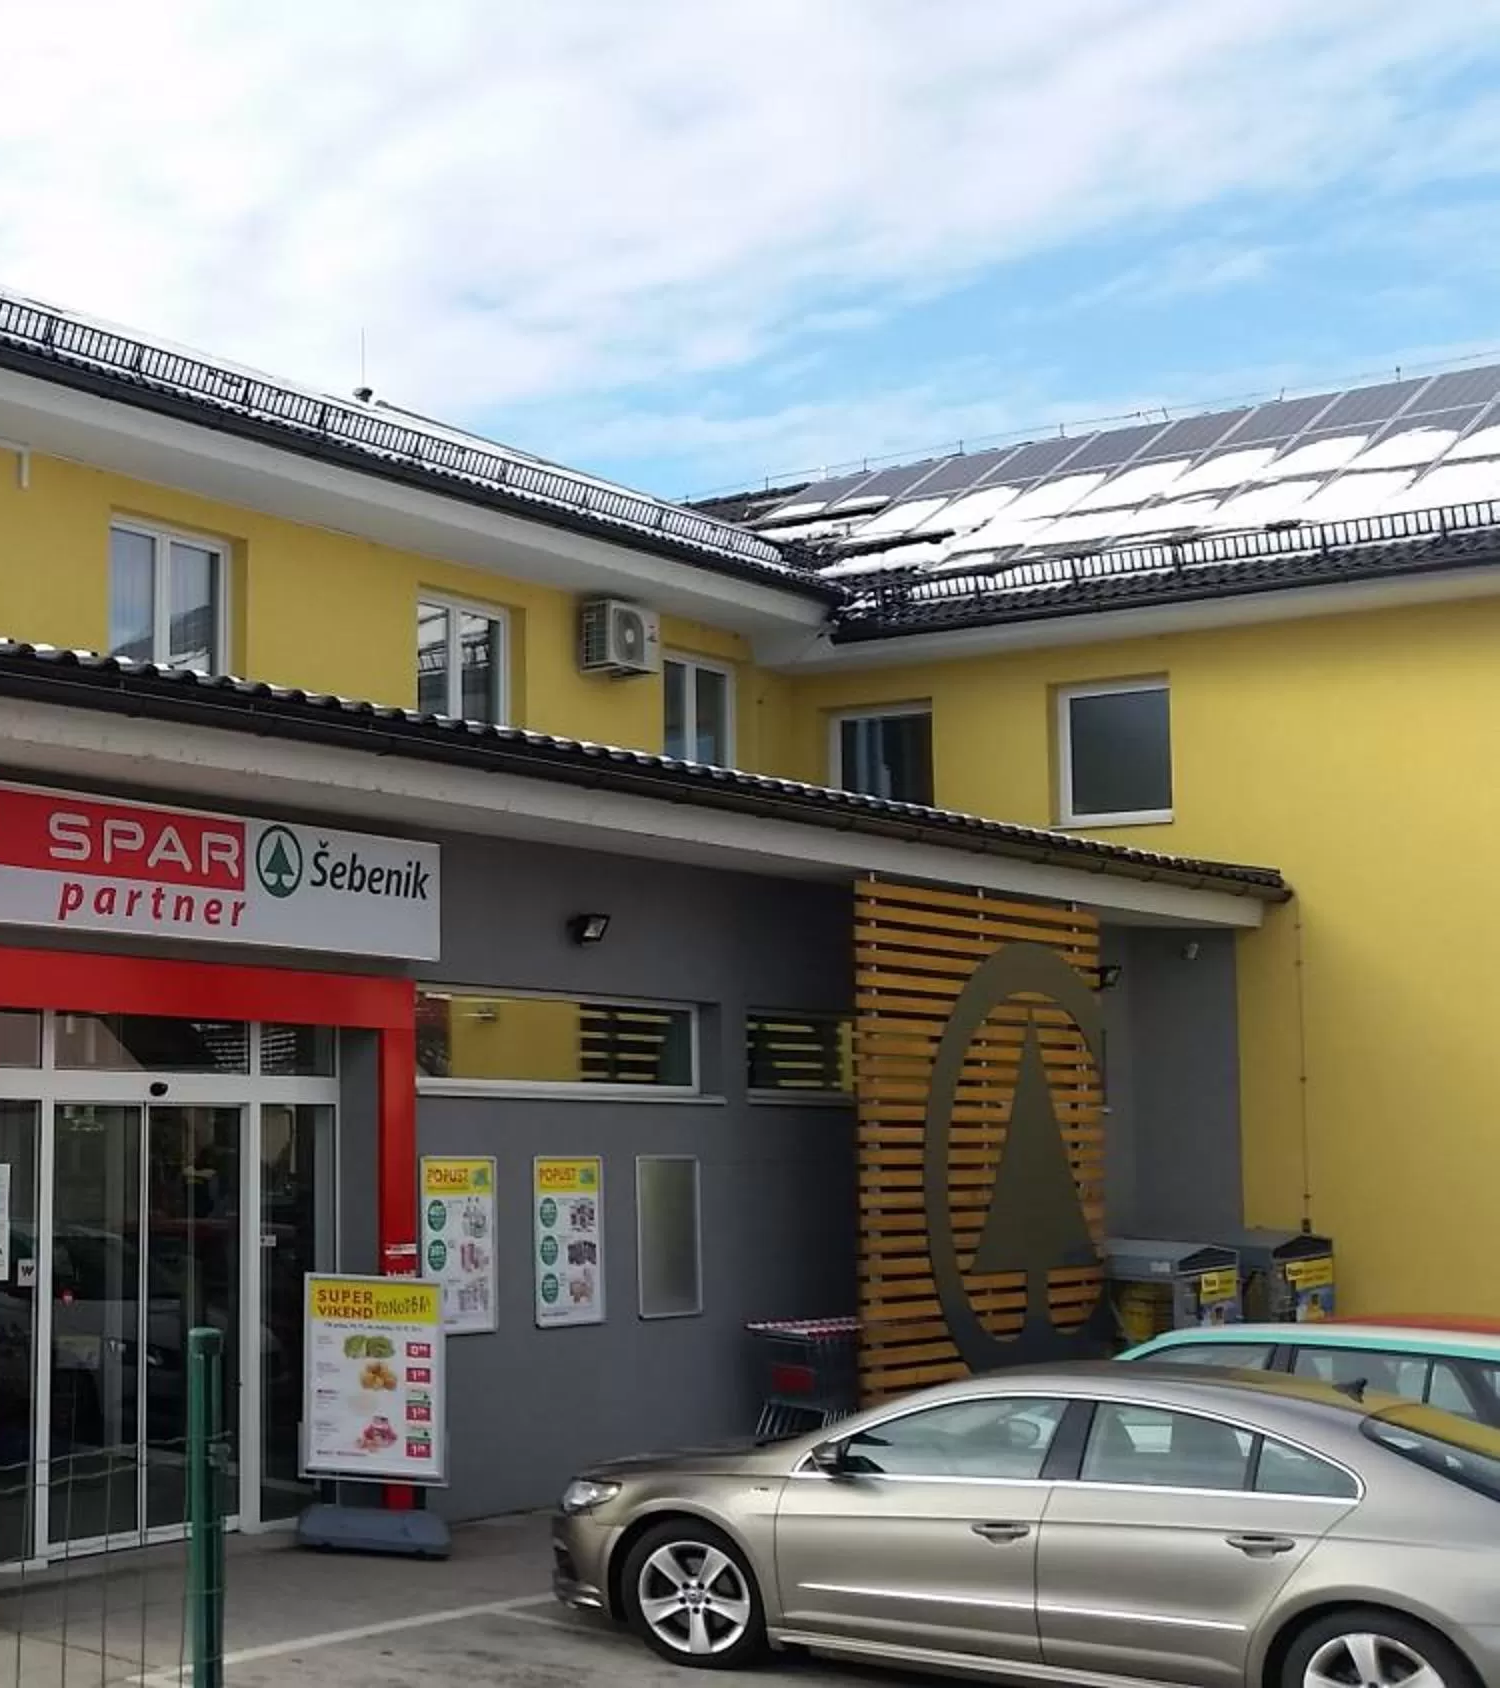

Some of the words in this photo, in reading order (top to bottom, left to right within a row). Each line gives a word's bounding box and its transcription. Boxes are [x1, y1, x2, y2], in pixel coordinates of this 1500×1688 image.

[48, 811, 240, 878] SPAR
[309, 840, 433, 901] Šebenik
[58, 878, 248, 928] partner
[317, 1289, 373, 1305] SUPER
[317, 1304, 373, 1319] VIKEND
